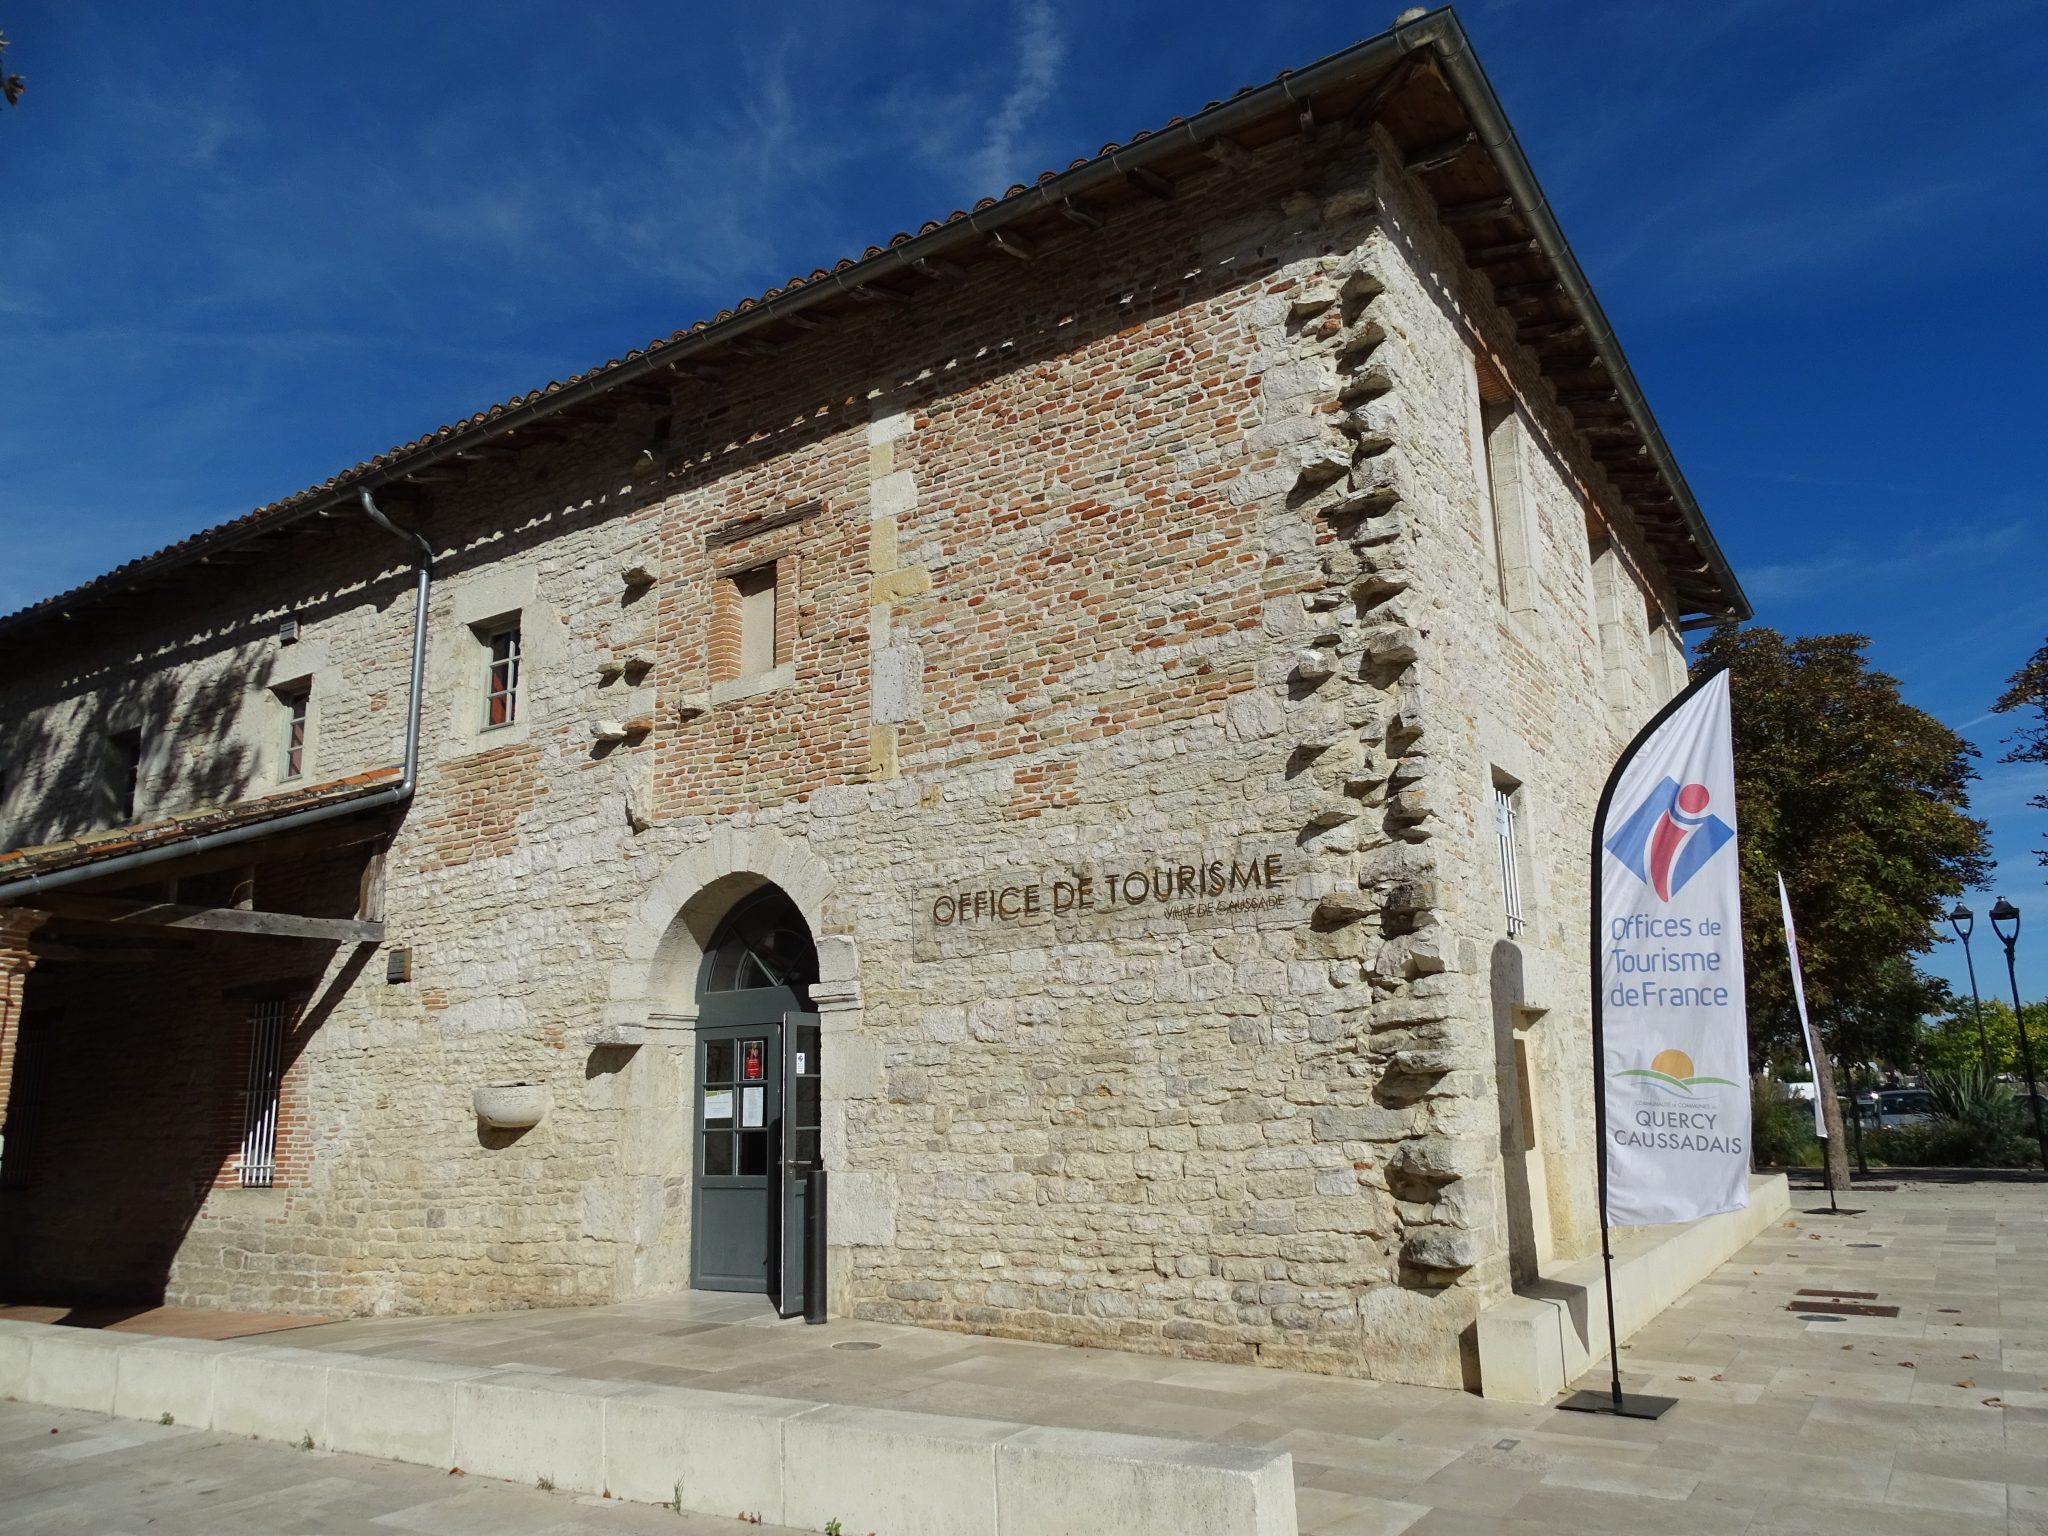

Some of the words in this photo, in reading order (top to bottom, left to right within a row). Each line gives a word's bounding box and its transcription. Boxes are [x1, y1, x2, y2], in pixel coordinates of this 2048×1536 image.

[933, 884, 1041, 924] OFFICE
[1053, 877, 1095, 914] DE
[1105, 853, 1287, 904] TOURISME
[1611, 913, 1693, 941] Offices
[1698, 917, 1722, 937] de
[1611, 946, 1721, 974] Tourisme
[1635, 1110, 1718, 1130] QUERCY
[1614, 1129, 1743, 1155] CAUSSADAIS
